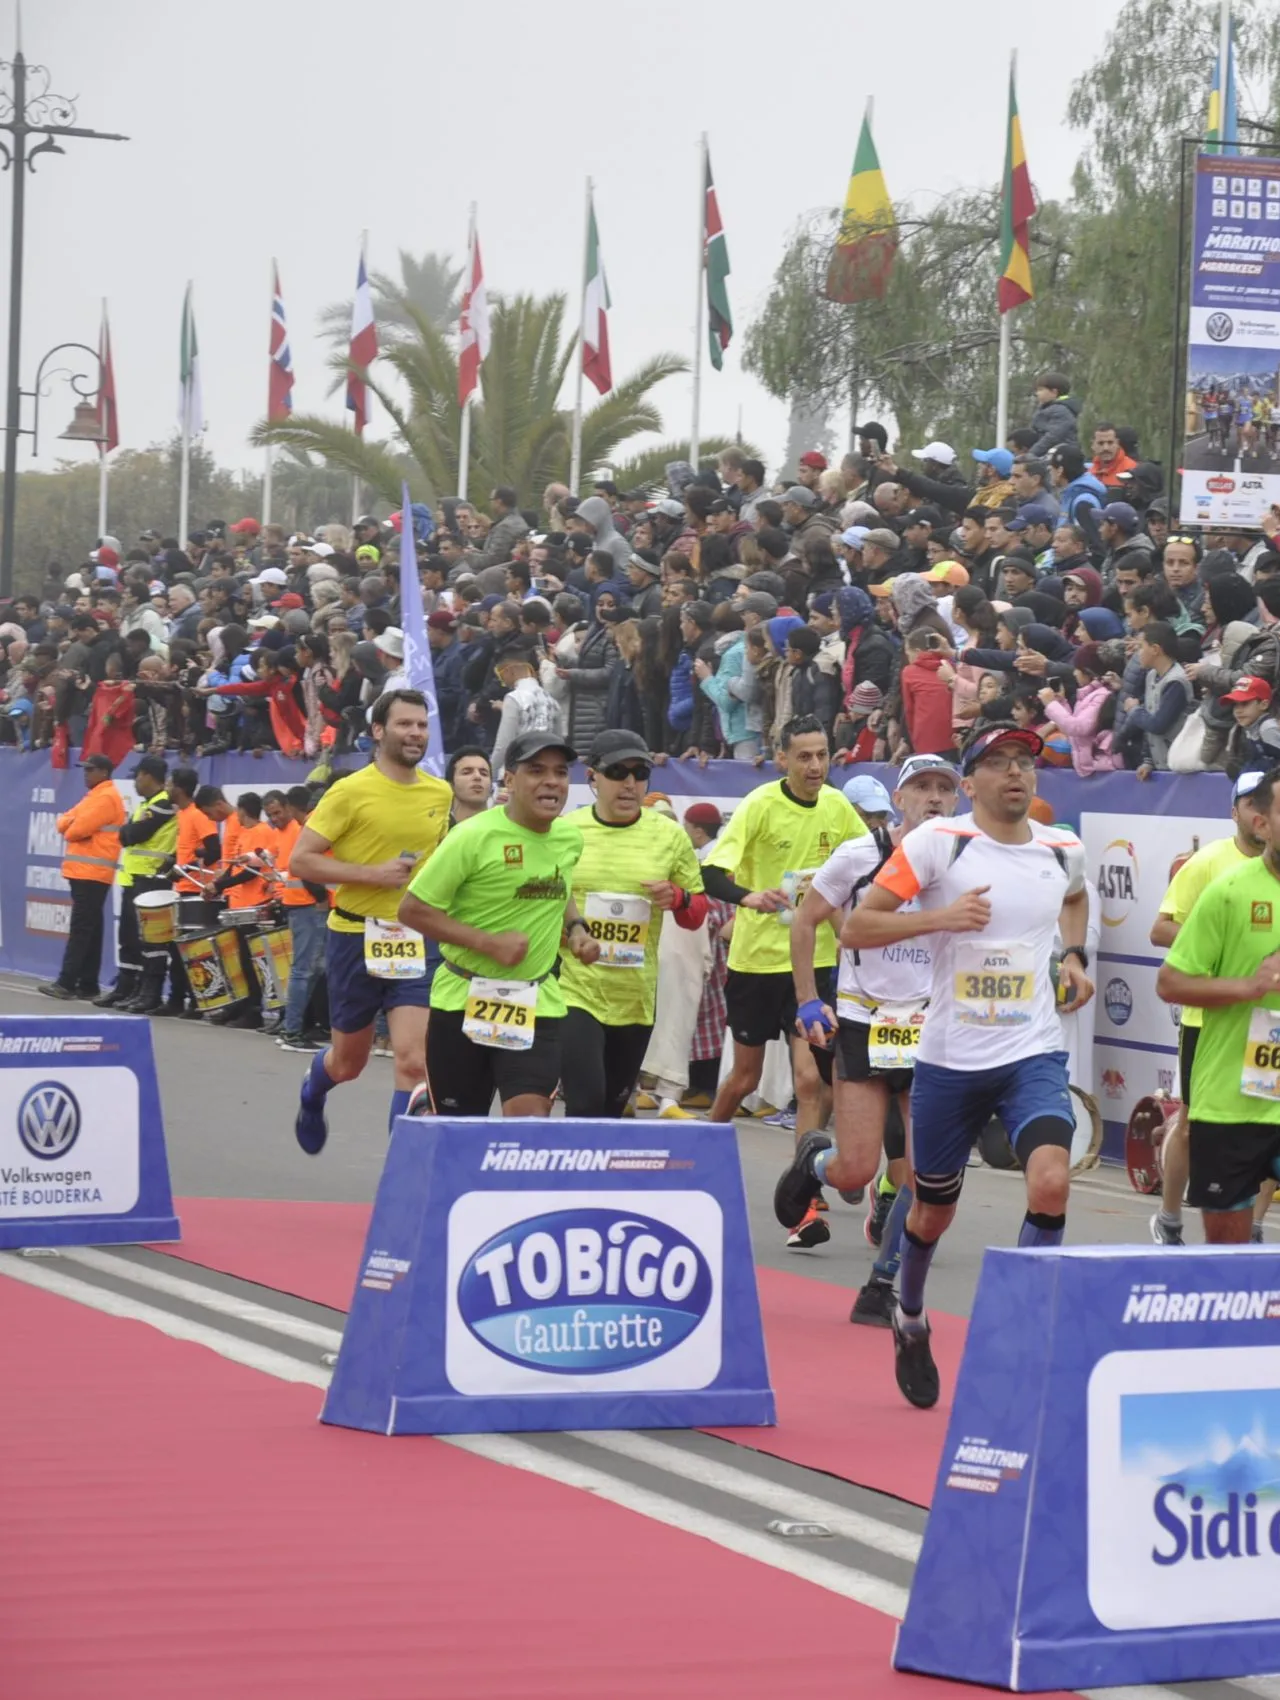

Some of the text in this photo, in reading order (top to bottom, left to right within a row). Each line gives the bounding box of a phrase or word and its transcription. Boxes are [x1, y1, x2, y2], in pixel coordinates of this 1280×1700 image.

[1097, 864, 1135, 900] ASTA
[590, 921, 641, 943] 8852
[371, 942, 417, 958] 6343
[984, 957, 1009, 966] ASTA
[965, 975, 1026, 998] 3867
[473, 1000, 527, 1026] 2775
[480, 1149, 612, 1171] MARATHON
[1, 1167, 92, 1186] Volkswagen
[0, 1187, 103, 1206] TÉ BOUDERKA
[1122, 1290, 1269, 1324] MARATHON
[514, 1309, 663, 1354] Gaufrette
[954, 1444, 1029, 1470] MARATHON
[1151, 1482, 1261, 1566] Sidi
